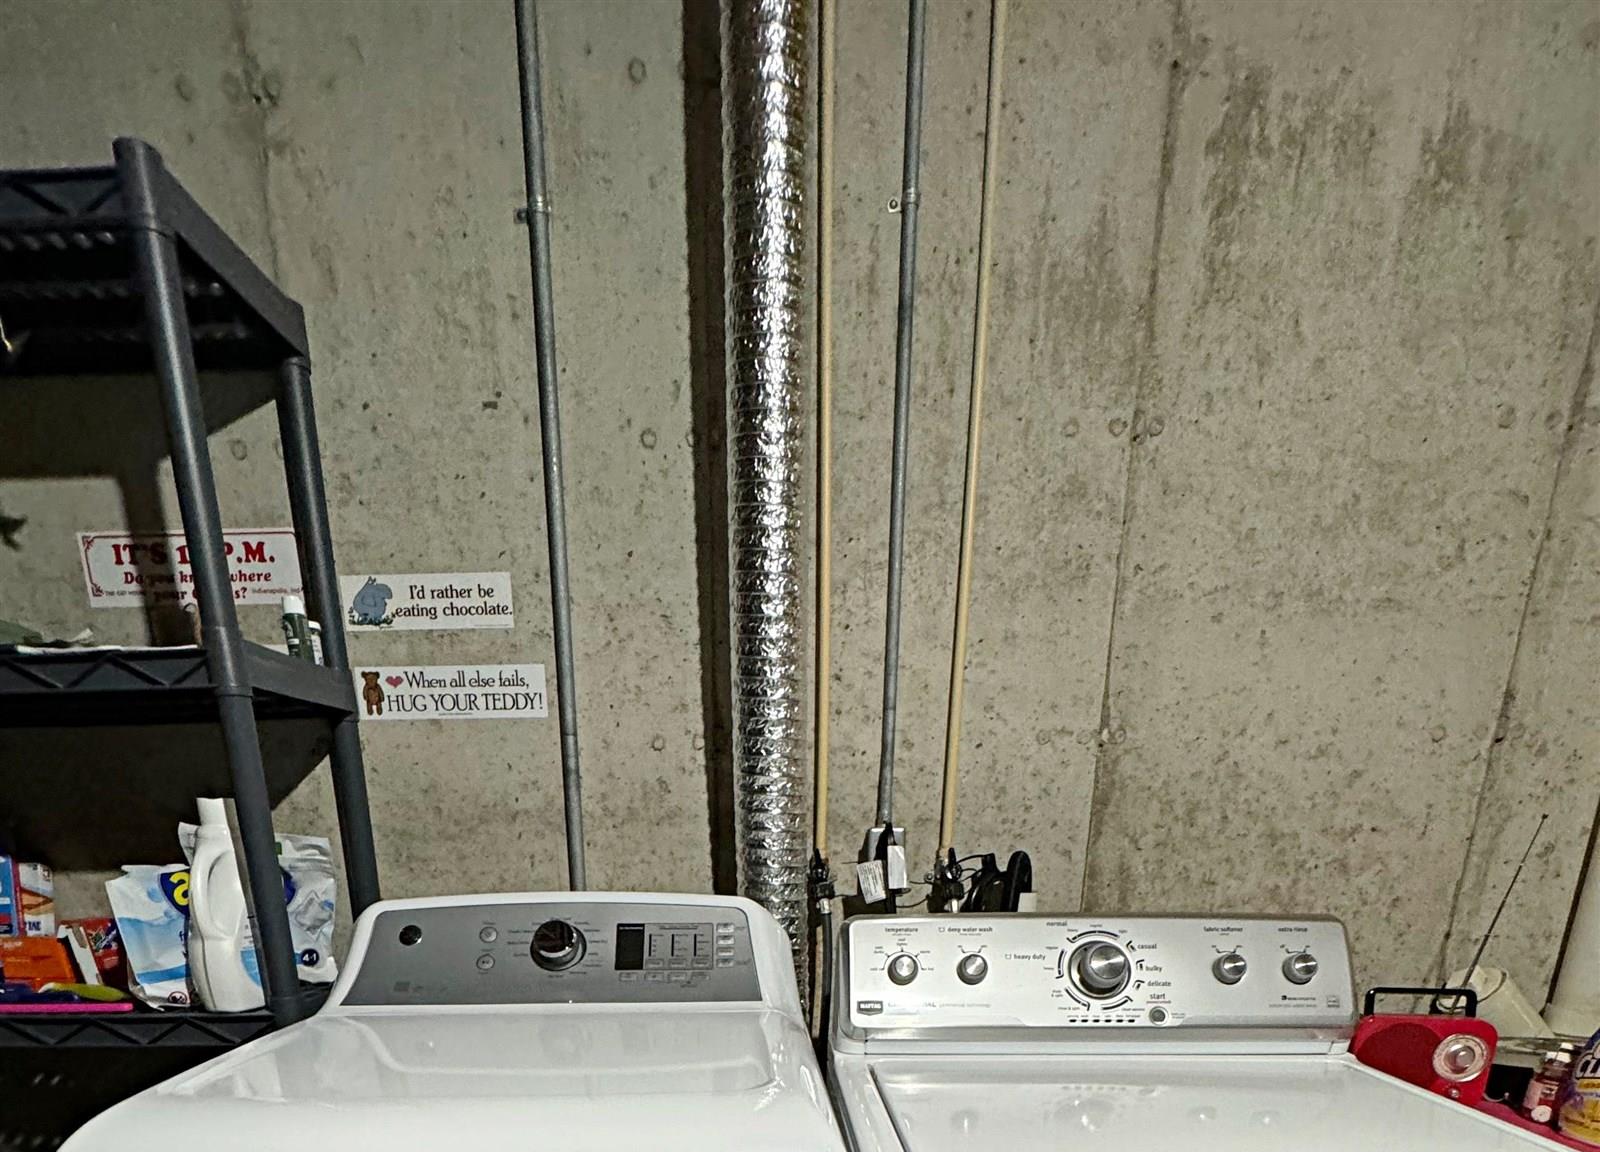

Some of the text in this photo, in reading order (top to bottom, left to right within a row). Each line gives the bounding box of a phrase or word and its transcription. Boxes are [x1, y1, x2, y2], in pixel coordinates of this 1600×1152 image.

[112, 542, 168, 565] IT'S
[123, 571, 144, 585] Do
[409, 583, 495, 600] I'd rather be
[395, 601, 513, 619] eating chocolate.
[403, 668, 530, 689] When all else fails,
[386, 691, 544, 712] HUG YOUR TEDDY!
[885, 926, 919, 934] temperature
[947, 926, 961, 934] deep
[1013, 953, 1046, 961] heavy duty
[1145, 965, 1163, 973] bulky
[1147, 980, 1172, 988] delicate
